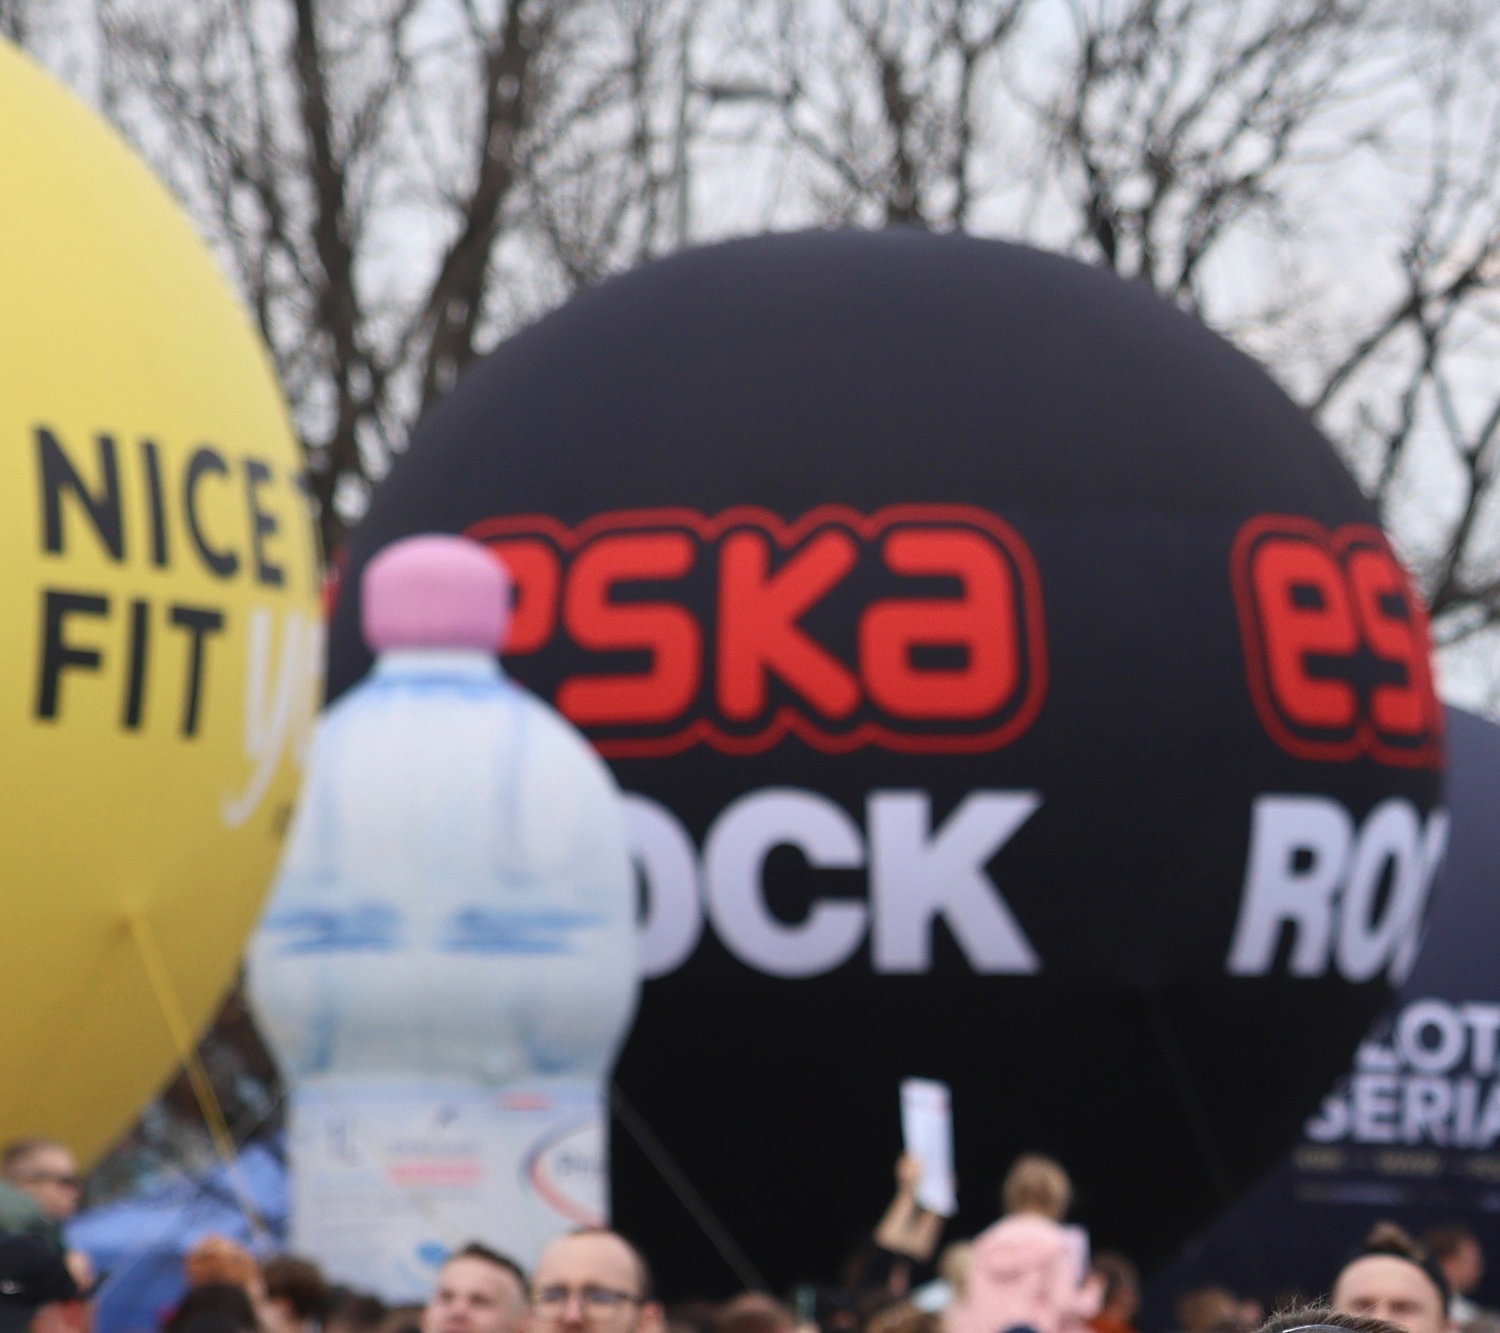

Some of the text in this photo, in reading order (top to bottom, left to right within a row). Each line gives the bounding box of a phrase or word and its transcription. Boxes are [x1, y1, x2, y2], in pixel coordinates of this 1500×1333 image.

[32, 423, 286, 588] NICE
[34, 588, 226, 741] FIT
[1242, 530, 1444, 745] es
[624, 786, 1044, 980] OCK
